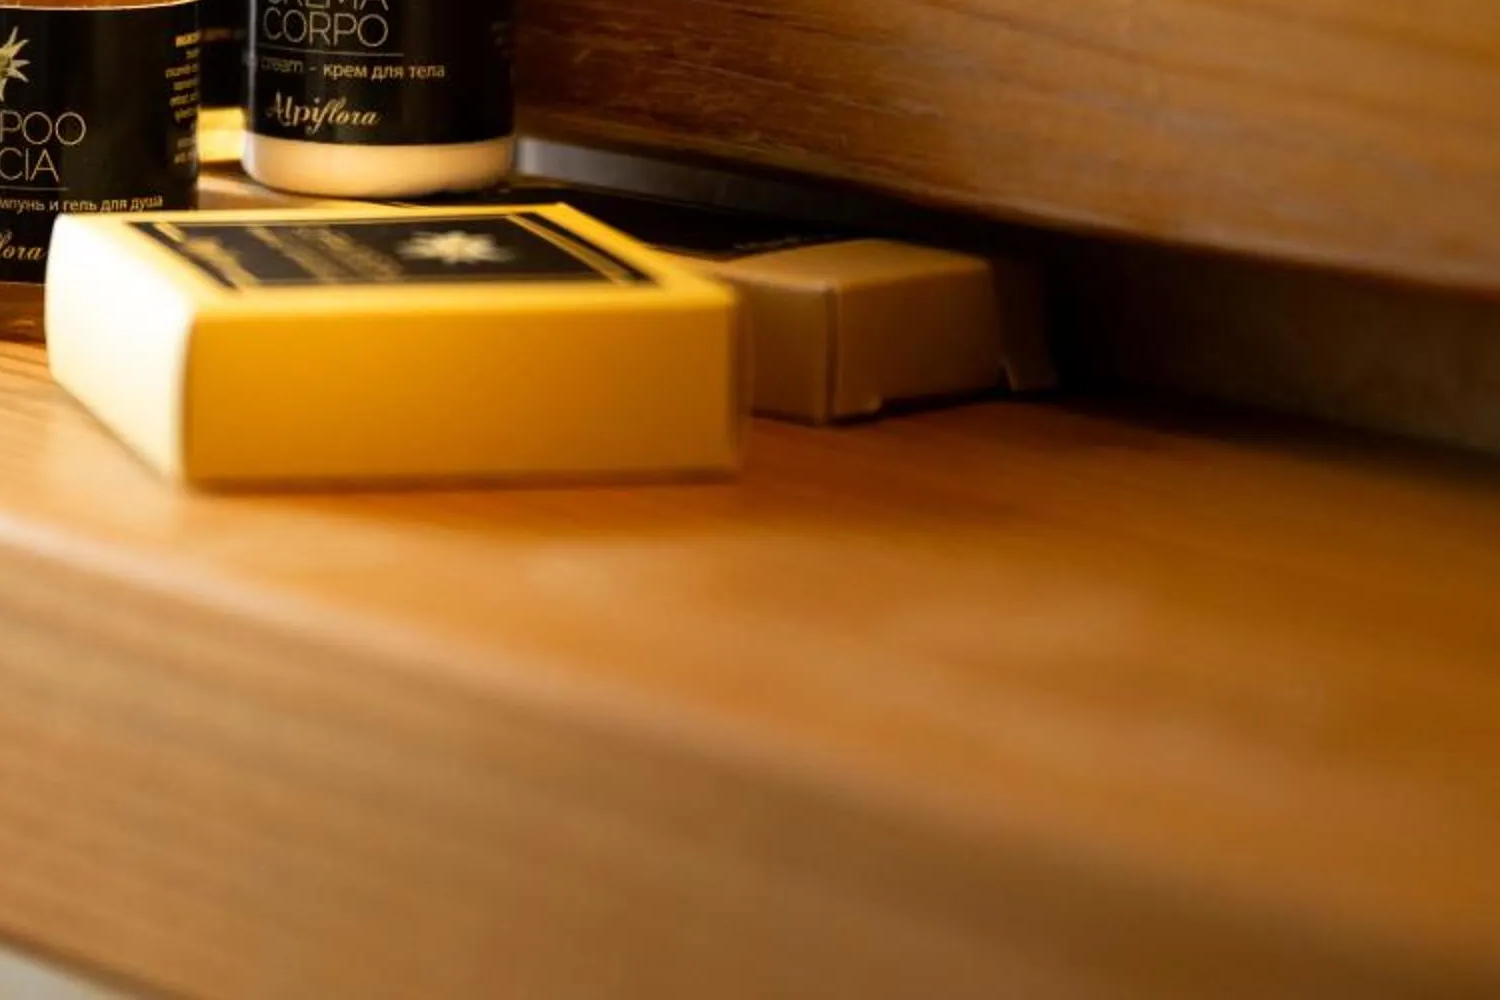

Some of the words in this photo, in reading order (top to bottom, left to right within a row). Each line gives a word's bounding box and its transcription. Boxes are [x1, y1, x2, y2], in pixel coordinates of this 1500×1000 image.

[262, 6, 389, 48] CORPO
[260, 56, 304, 74] cream
[322, 62, 367, 80] крем
[371, 63, 404, 82] для
[409, 63, 446, 79] тела
[266, 91, 381, 135] Alpiflora
[49, 199, 59, 212] и
[62, 199, 98, 213] гель
[100, 198, 128, 213] для
[130, 194, 164, 213] душа
